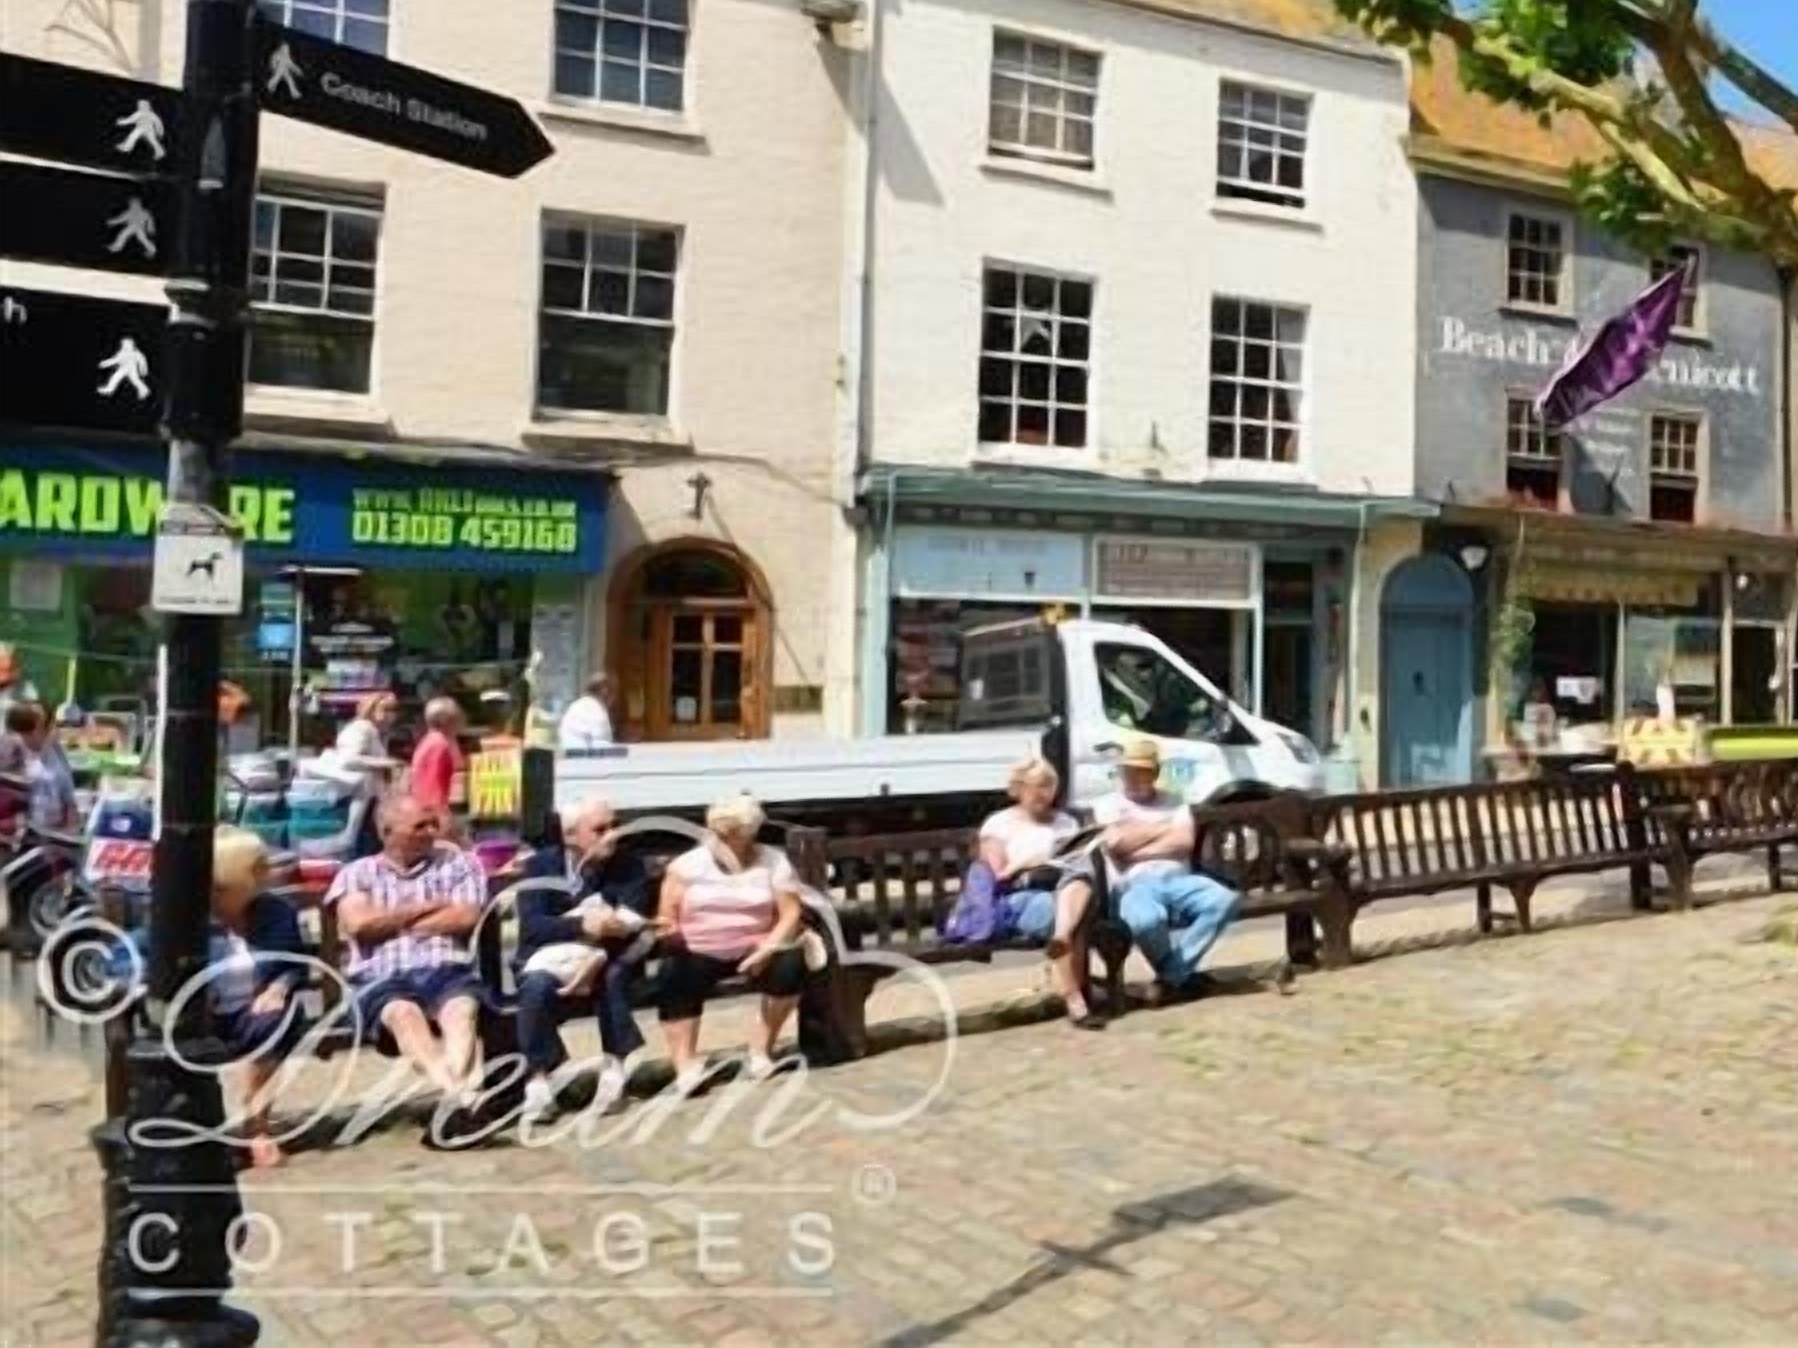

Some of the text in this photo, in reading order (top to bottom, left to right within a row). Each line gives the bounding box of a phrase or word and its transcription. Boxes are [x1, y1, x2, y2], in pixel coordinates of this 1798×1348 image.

[319, 71, 489, 141] Coach Station
[1441, 316, 1549, 365] Beach
[0, 469, 295, 543] ARDWRE
[352, 510, 453, 546] 01308
